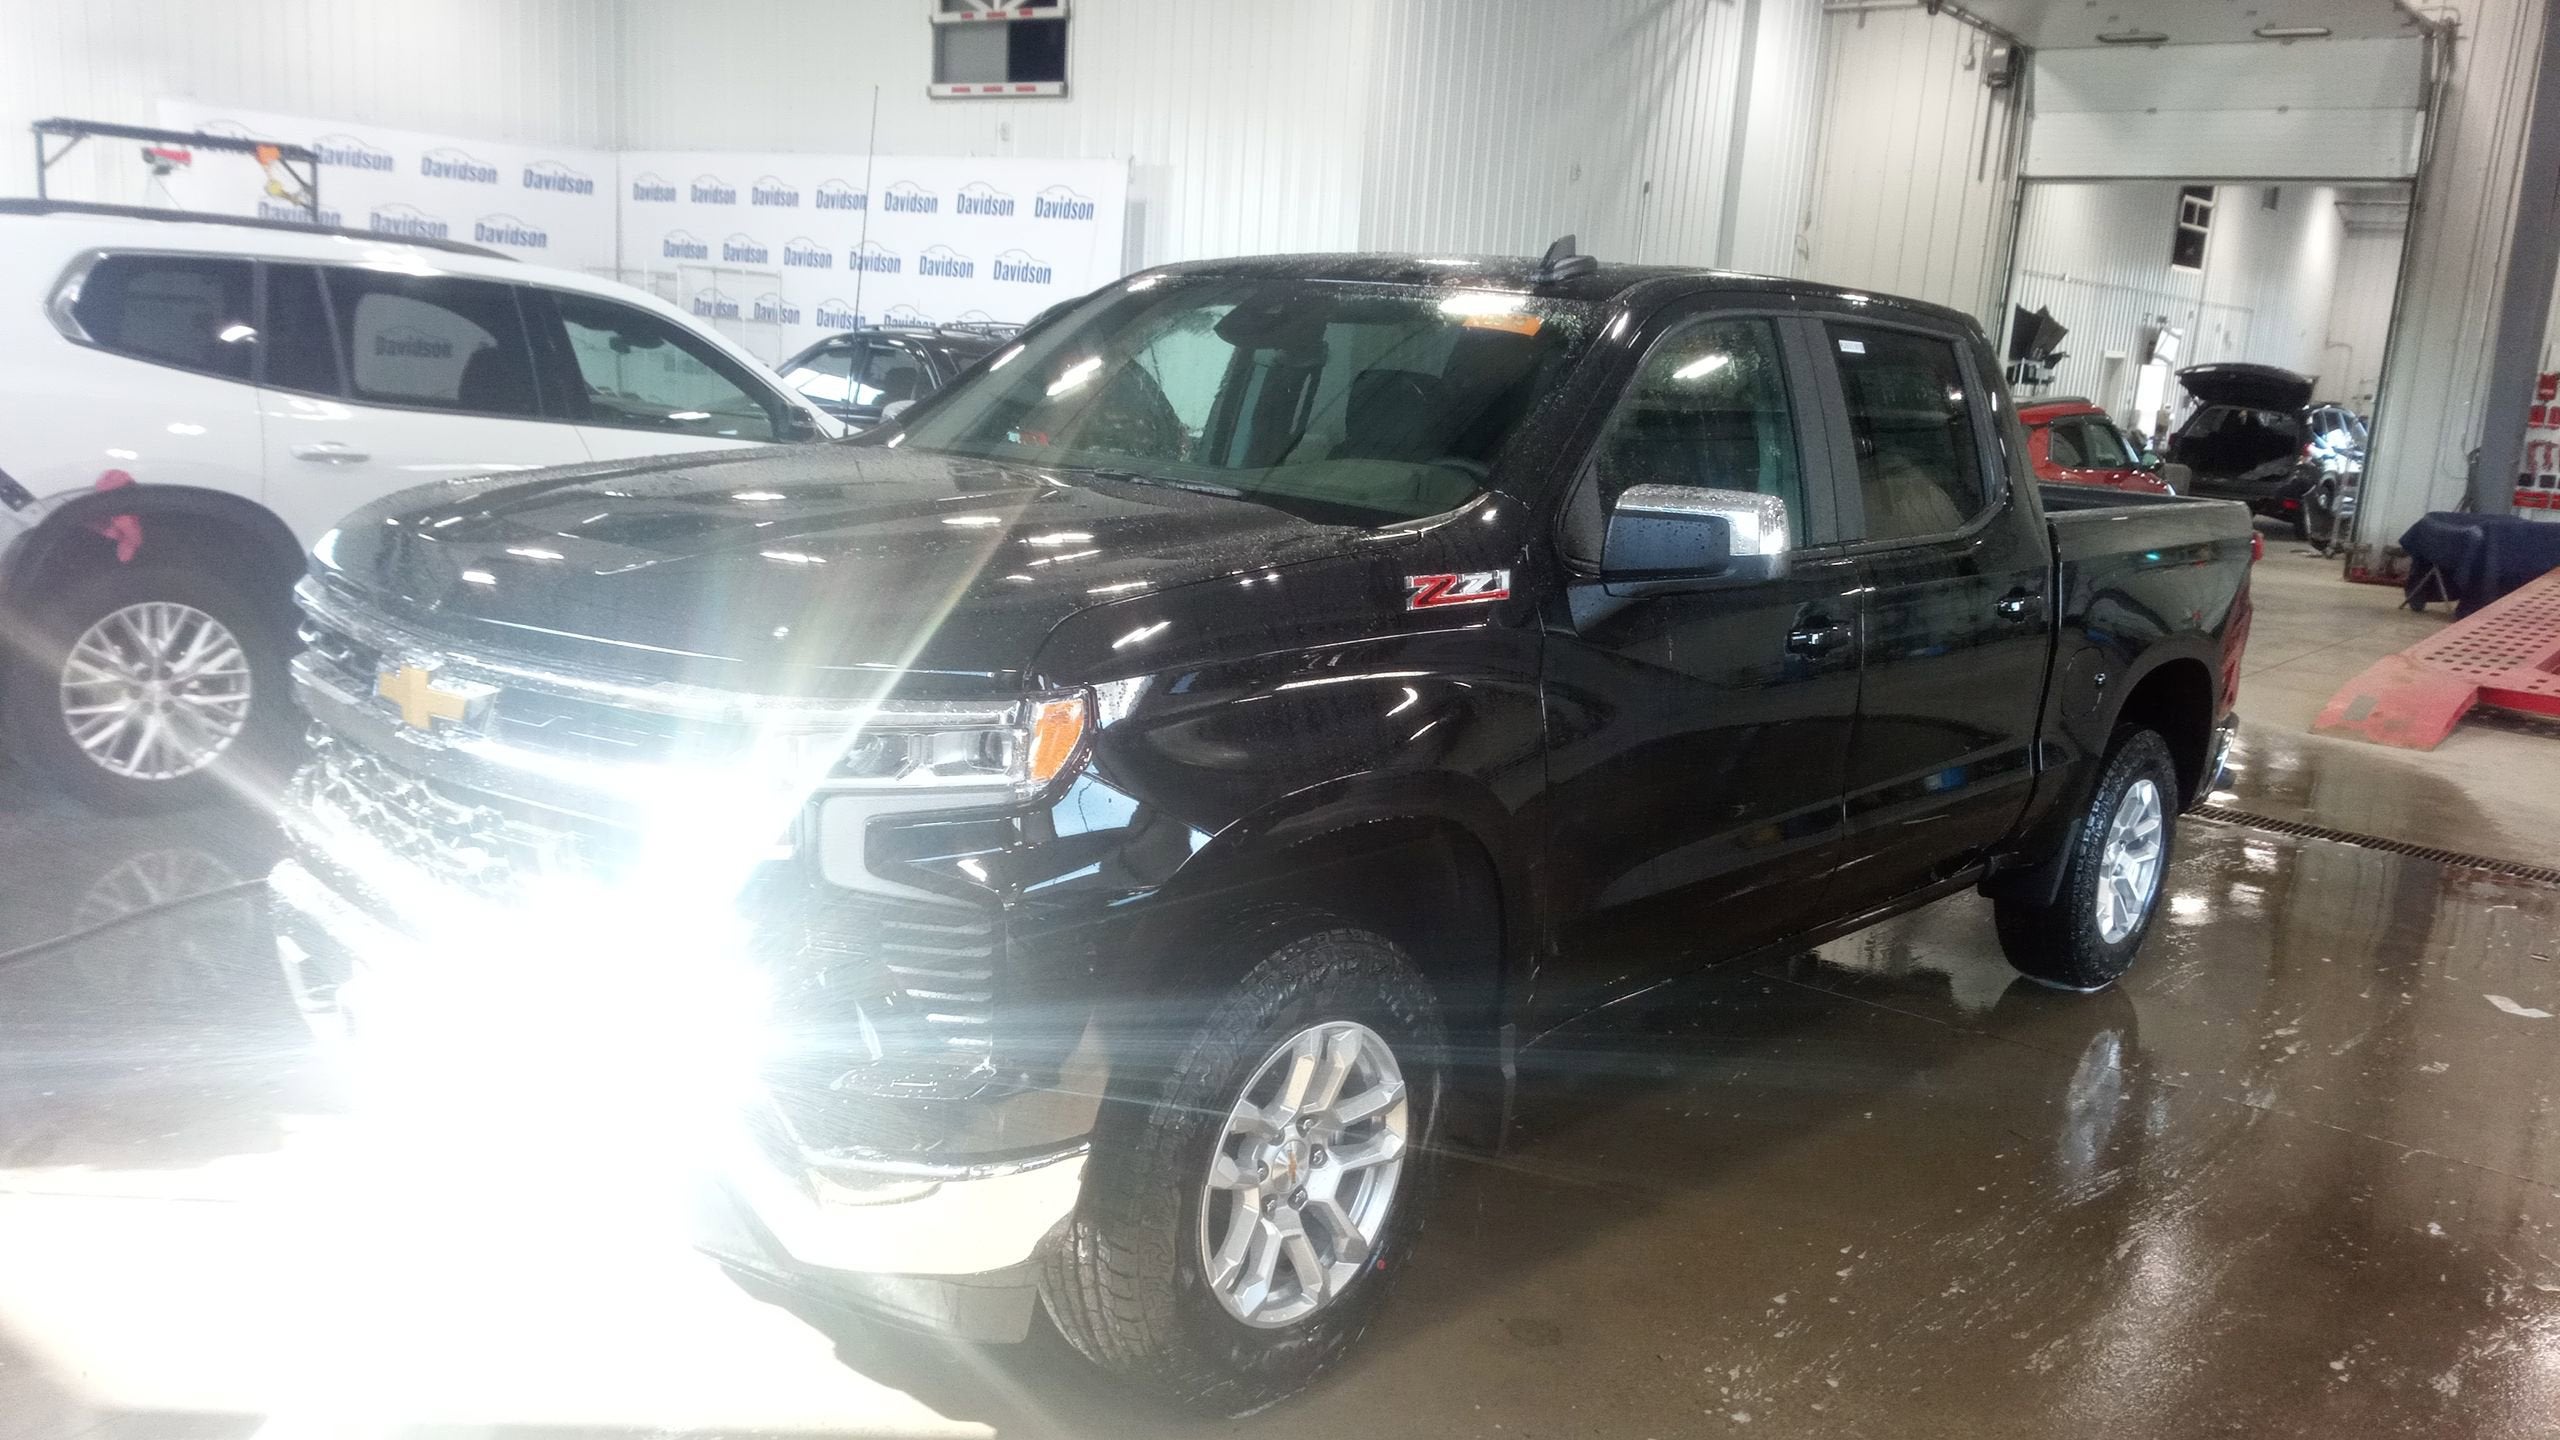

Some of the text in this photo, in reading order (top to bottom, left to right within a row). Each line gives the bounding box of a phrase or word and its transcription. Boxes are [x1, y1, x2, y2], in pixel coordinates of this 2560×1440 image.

[313, 143, 393, 172] Davidson
[421, 156, 498, 184] Davidson
[522, 168, 594, 195] Davidson
[633, 182, 677, 203] Davidson
[691, 183, 737, 206] Davidson
[752, 186, 800, 208] Davidson
[816, 189, 868, 210] Davidson
[884, 191, 939, 213] Davidson
[257, 201, 342, 226] Davidon
[957, 193, 1015, 216] Davidson
[1034, 196, 1095, 220] Davidson
[369, 212, 448, 240] Davidson
[474, 222, 547, 248] Davidson
[663, 239, 708, 260] Davidson
[723, 243, 769, 264] Davidson
[784, 246, 833, 269] Davidson
[849, 251, 902, 273] Davidson
[919, 255, 975, 279] Davidson
[993, 260, 1052, 285] Davidson
[694, 297, 739, 319] Davidson
[754, 302, 800, 325] Davidson
[816, 307, 866, 331] Davidson
[375, 335, 454, 358] Davidson
[1404, 569, 1511, 611] Z71
